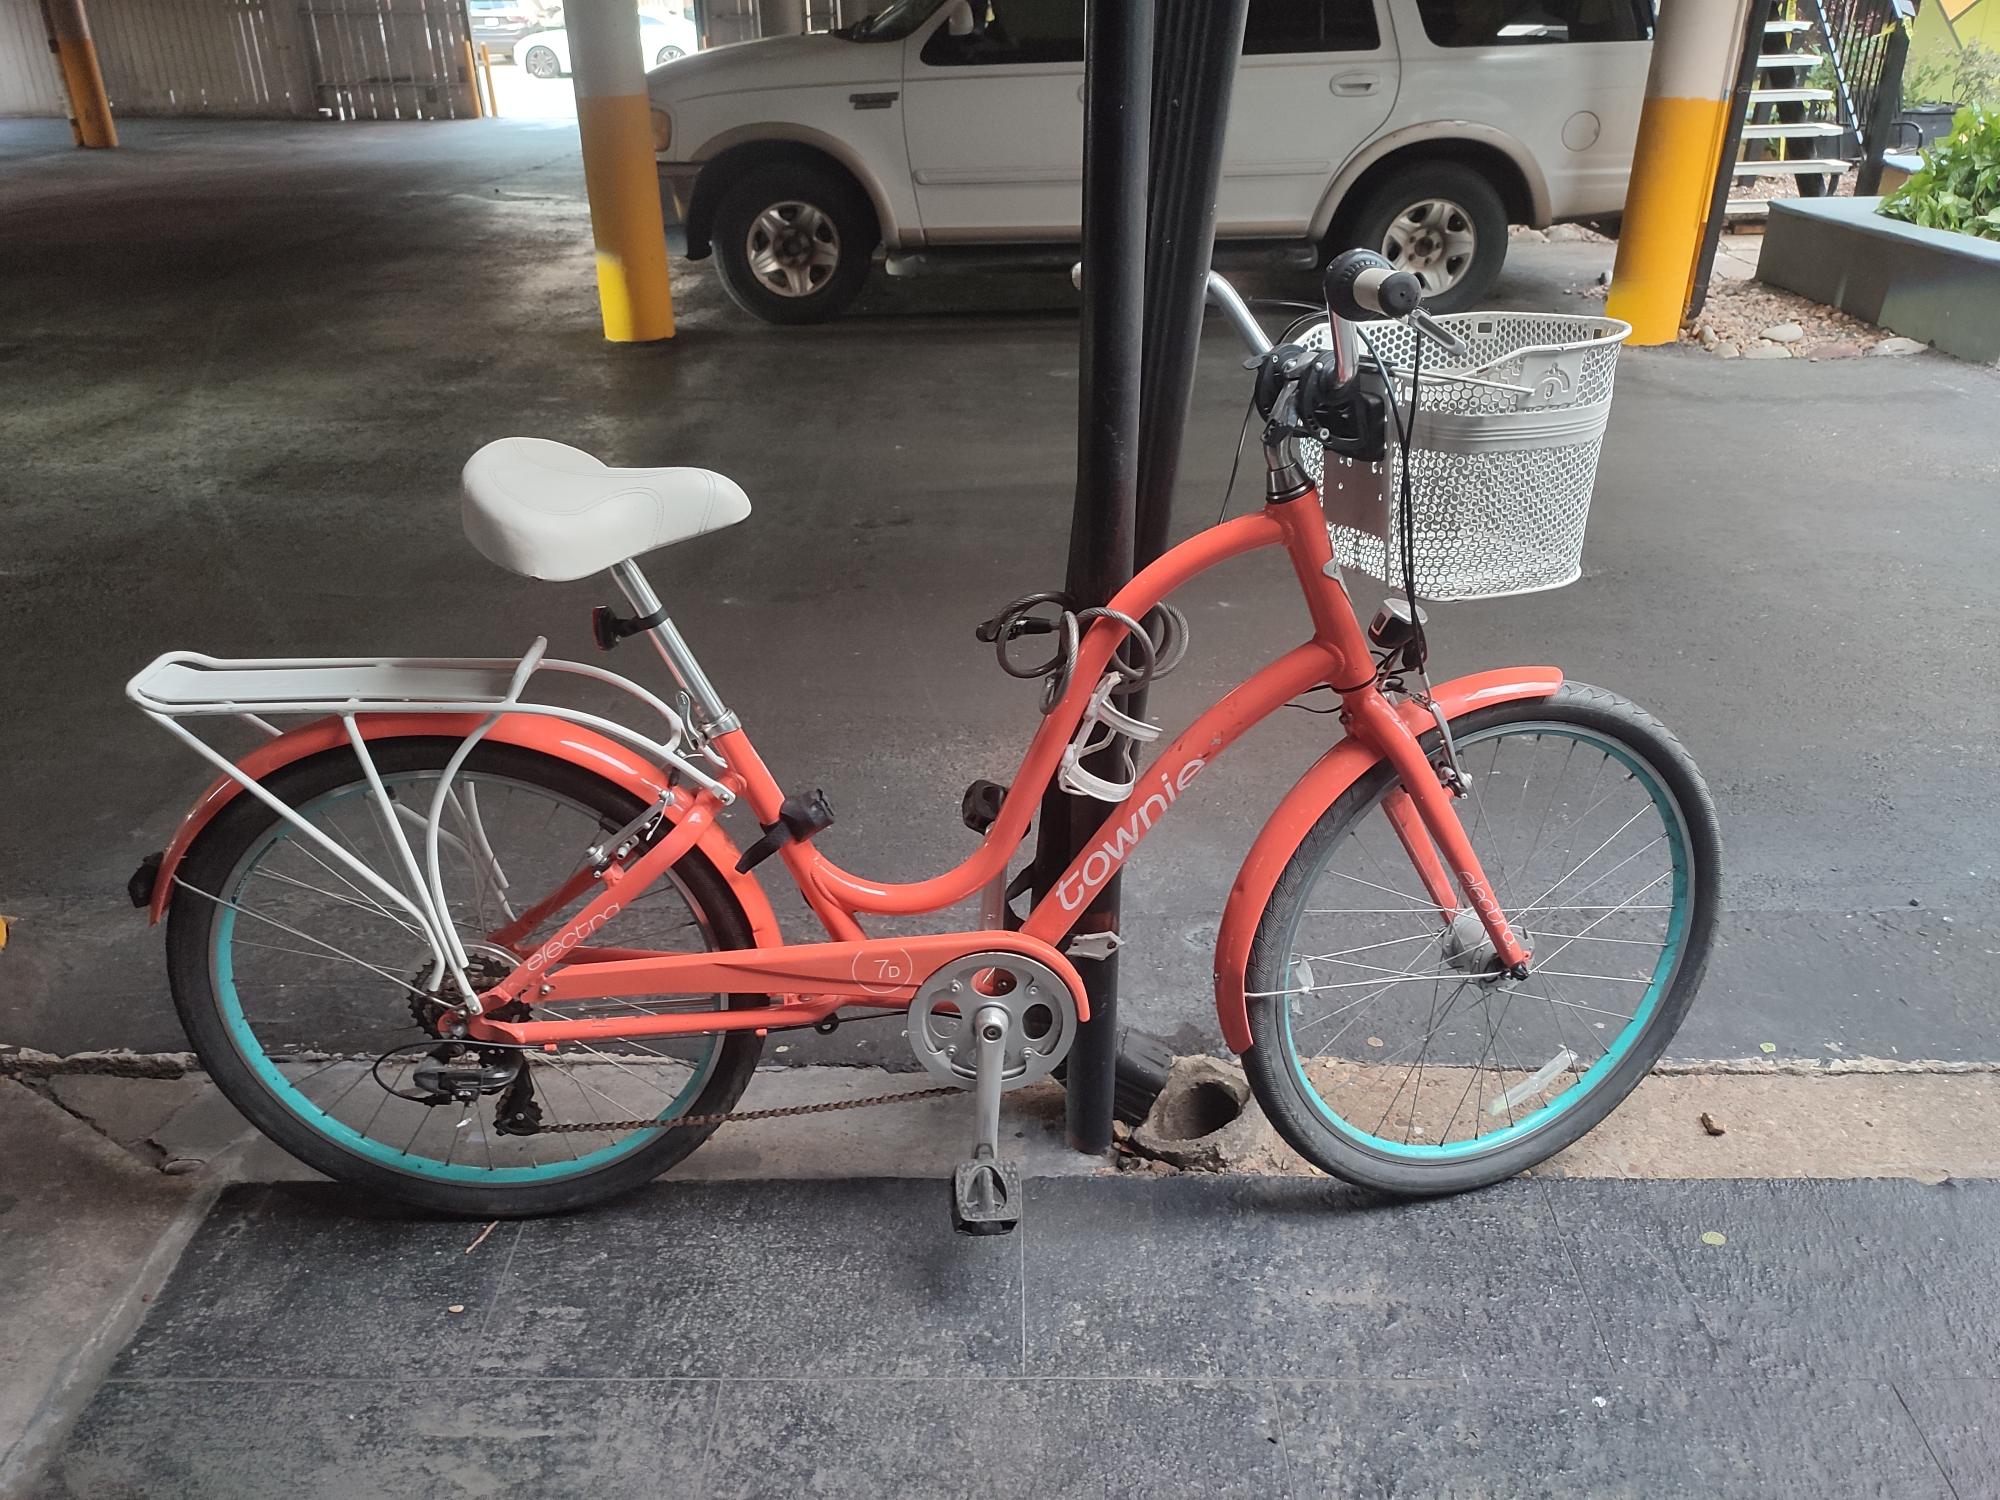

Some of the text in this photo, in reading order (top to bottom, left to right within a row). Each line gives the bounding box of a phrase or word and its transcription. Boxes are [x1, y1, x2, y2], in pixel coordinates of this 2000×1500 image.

[1056, 758, 1206, 911] townie
[527, 902, 620, 971] electra
[1459, 871, 1516, 946] electra
[873, 959, 901, 979] 7D
